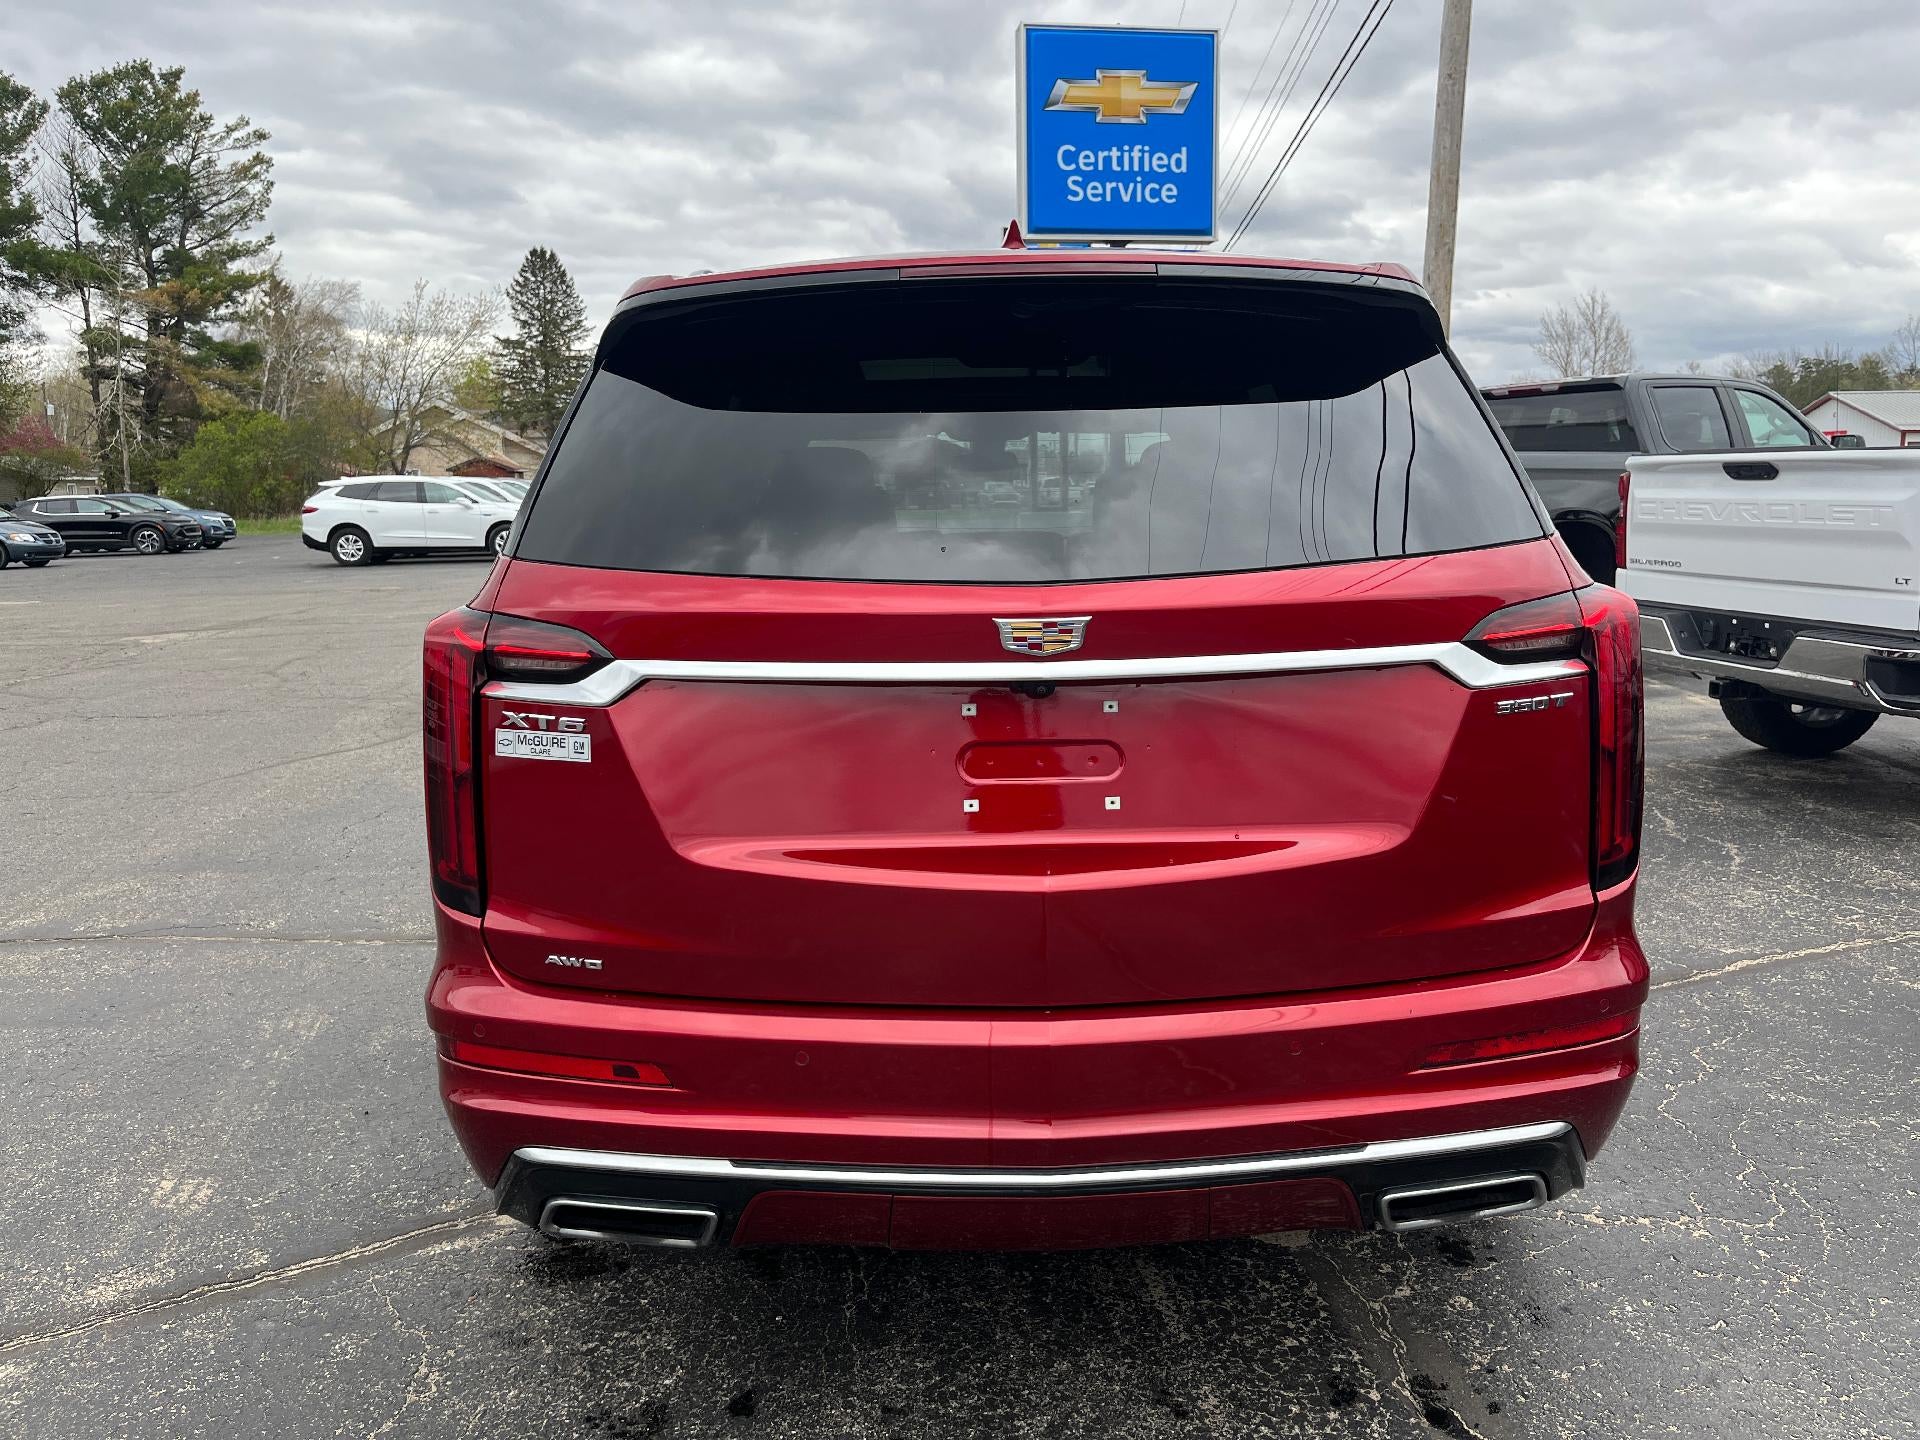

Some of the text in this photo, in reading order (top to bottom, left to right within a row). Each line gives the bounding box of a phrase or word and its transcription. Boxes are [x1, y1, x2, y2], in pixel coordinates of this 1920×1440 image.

[1056, 144, 1188, 173] Certified
[1066, 175, 1178, 204] Service
[1637, 501, 1895, 526] CHEVROLET
[1629, 558, 1682, 568] SILVERADO
[1895, 577, 1912, 585] LT
[501, 710, 586, 732] XT6
[517, 734, 566, 749] McGUIRE
[573, 741, 585, 751] GM
[530, 747, 551, 755] CLARE
[544, 955, 603, 970] AWD
